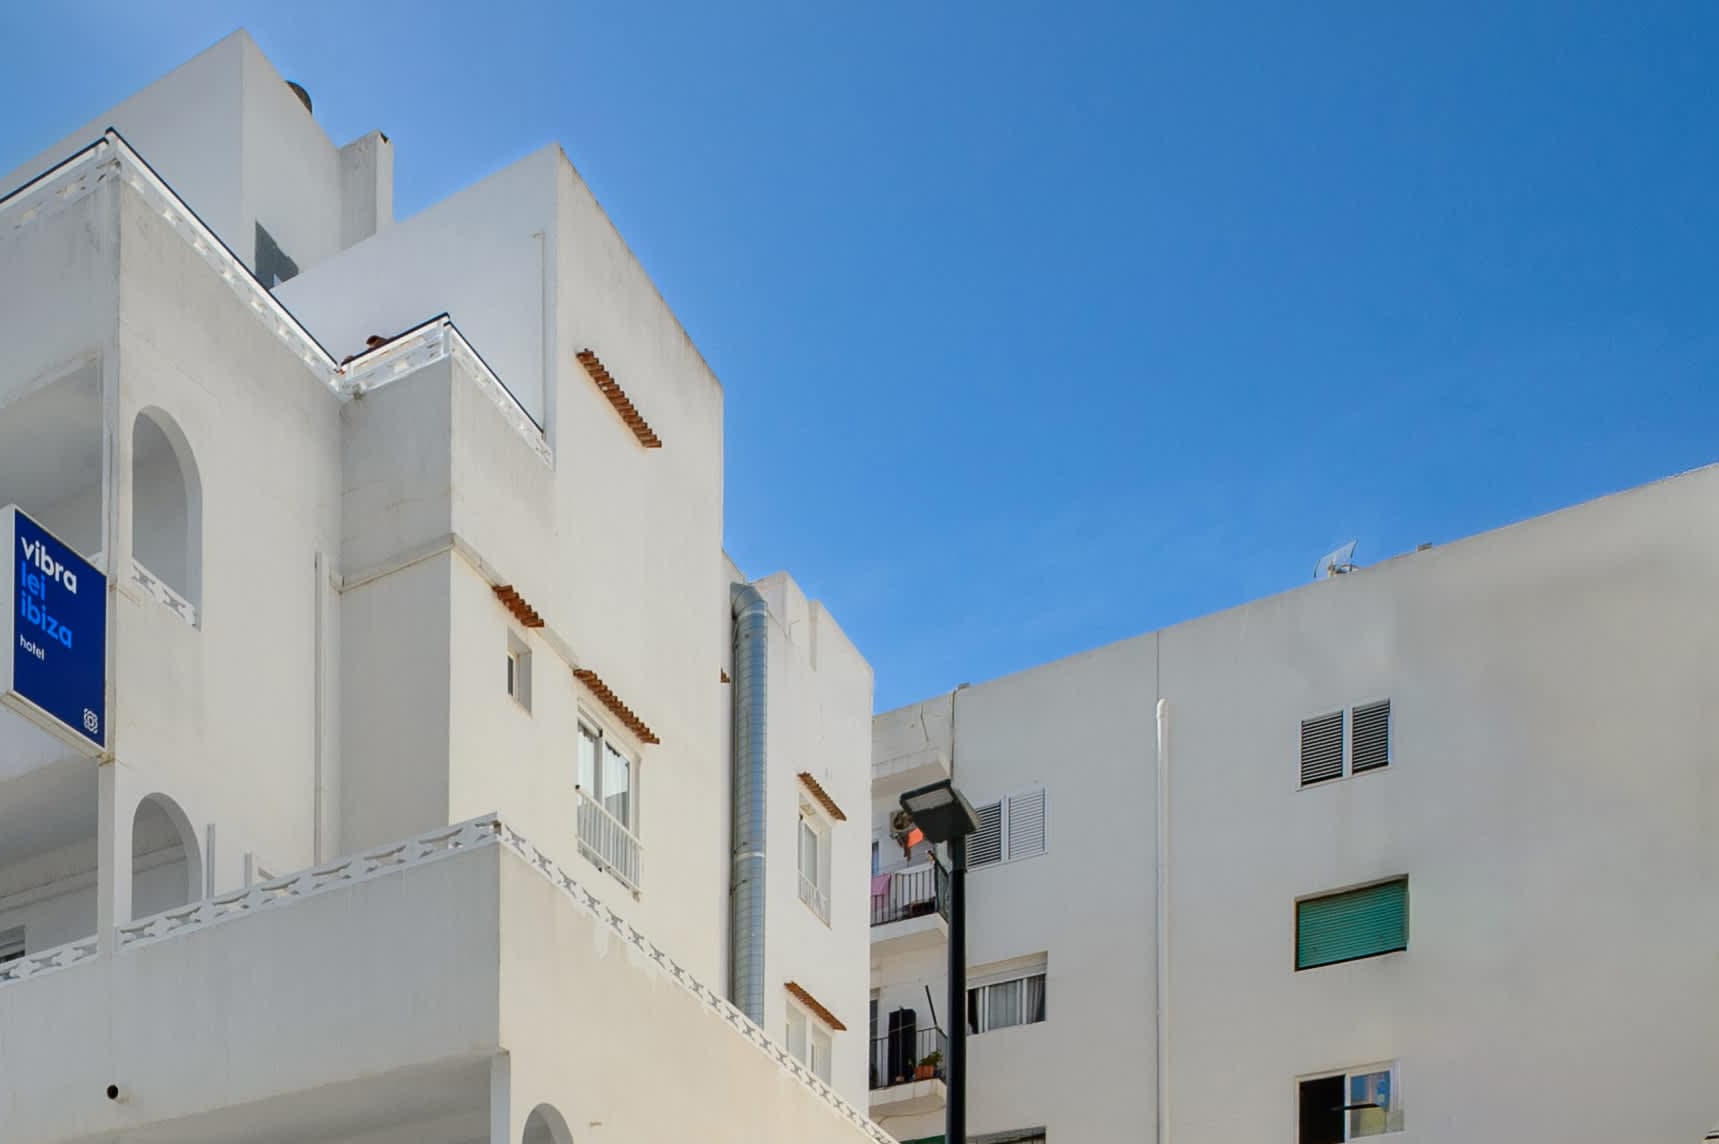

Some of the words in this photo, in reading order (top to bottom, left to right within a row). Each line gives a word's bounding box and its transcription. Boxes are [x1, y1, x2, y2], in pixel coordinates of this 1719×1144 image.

[21, 536, 78, 594] vibra
[21, 560, 46, 600] lei
[21, 591, 73, 649] ibiza
[20, 634, 45, 661] hotel
